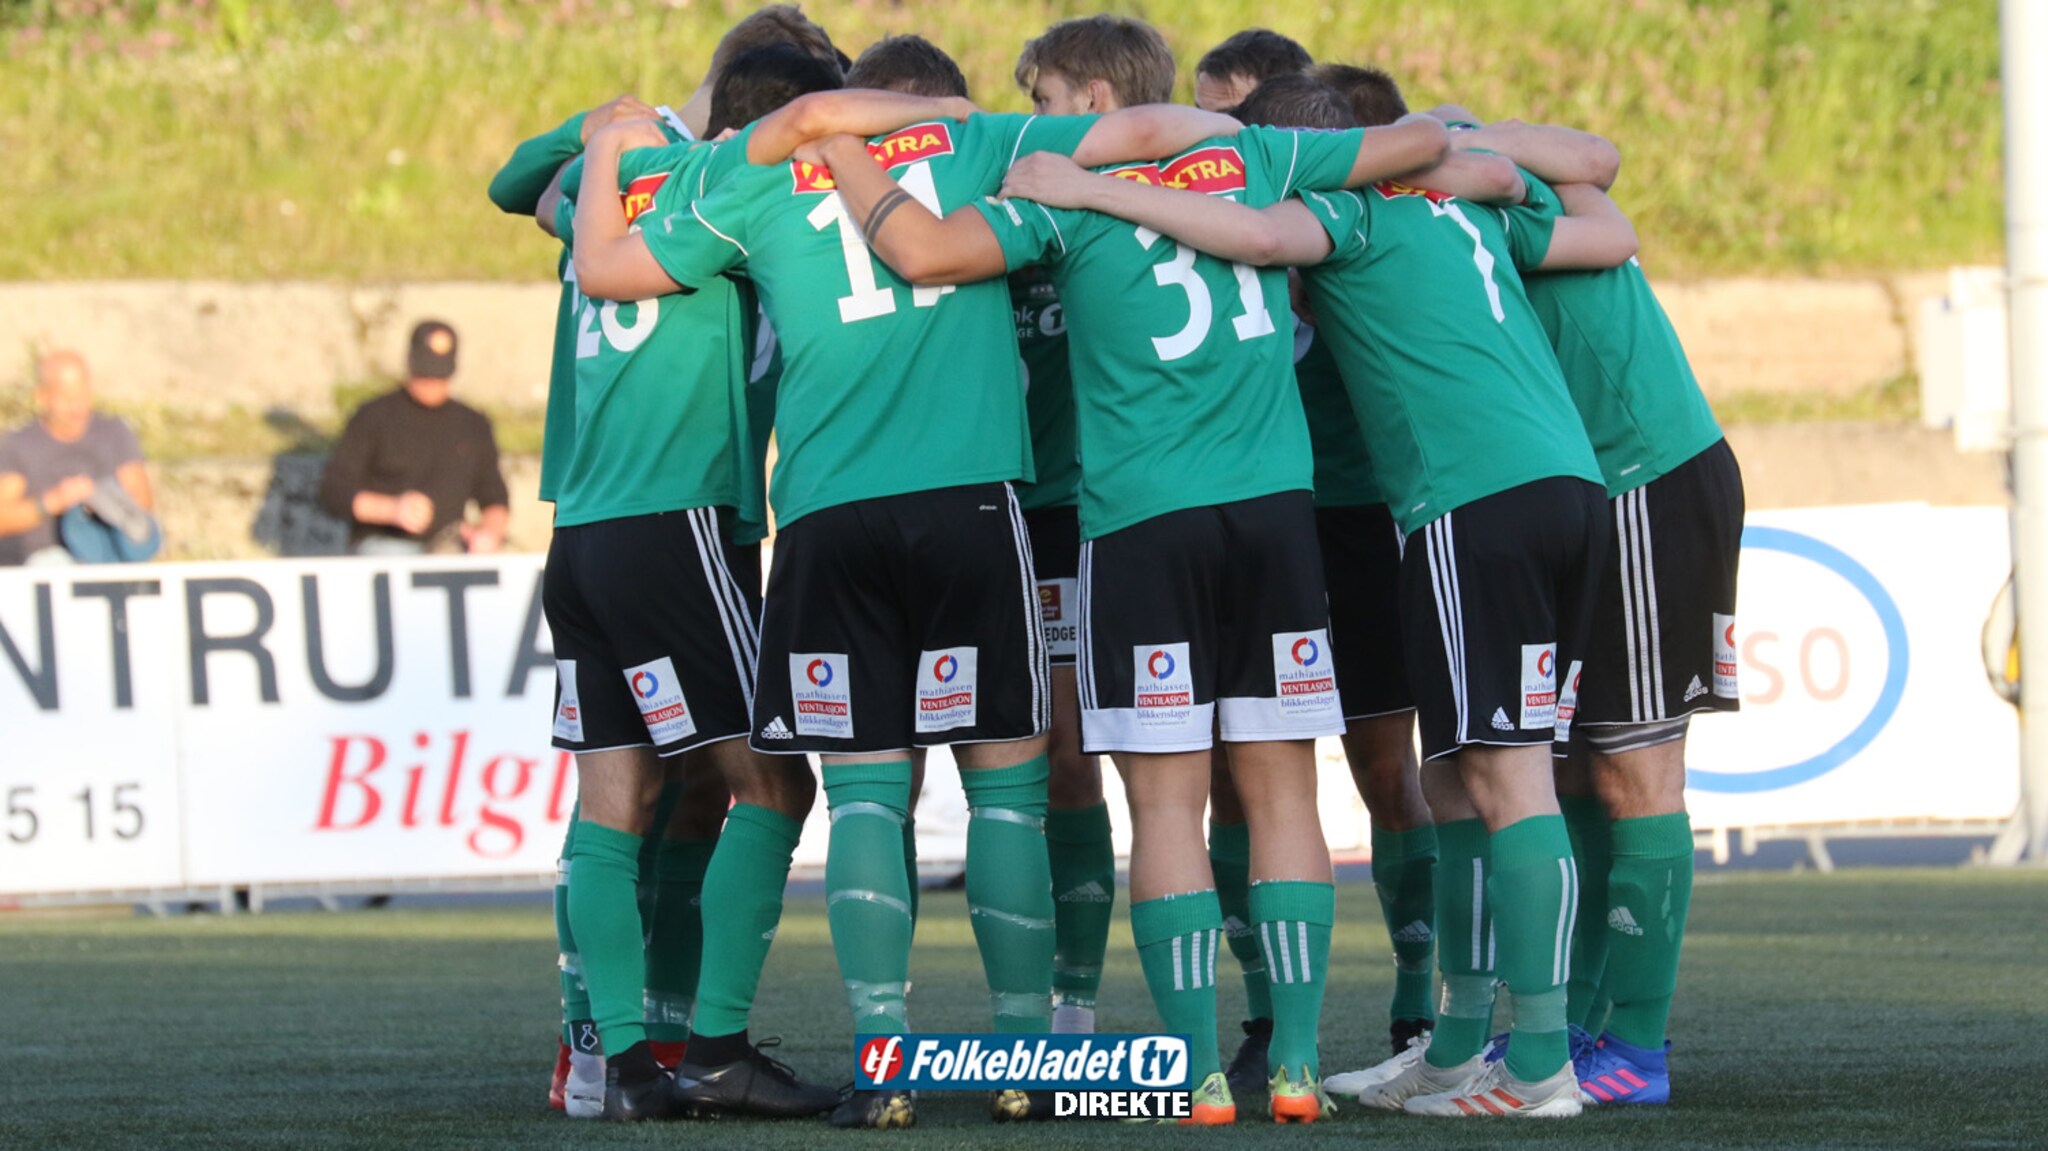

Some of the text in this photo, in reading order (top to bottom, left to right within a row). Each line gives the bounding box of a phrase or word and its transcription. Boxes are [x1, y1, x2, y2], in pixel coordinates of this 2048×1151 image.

[874, 133, 942, 161] TRA
[1160, 158, 1242, 190] XTRA
[1137, 683, 1190, 692] mathiassen
[1281, 680, 1333, 694] VENTILASJON
[922, 694, 971, 710] VENTILASJON
[1138, 695, 1189, 706] VENTILASJON
[799, 702, 847, 715] VENTILASJON
[73, 782, 144, 841] 15
